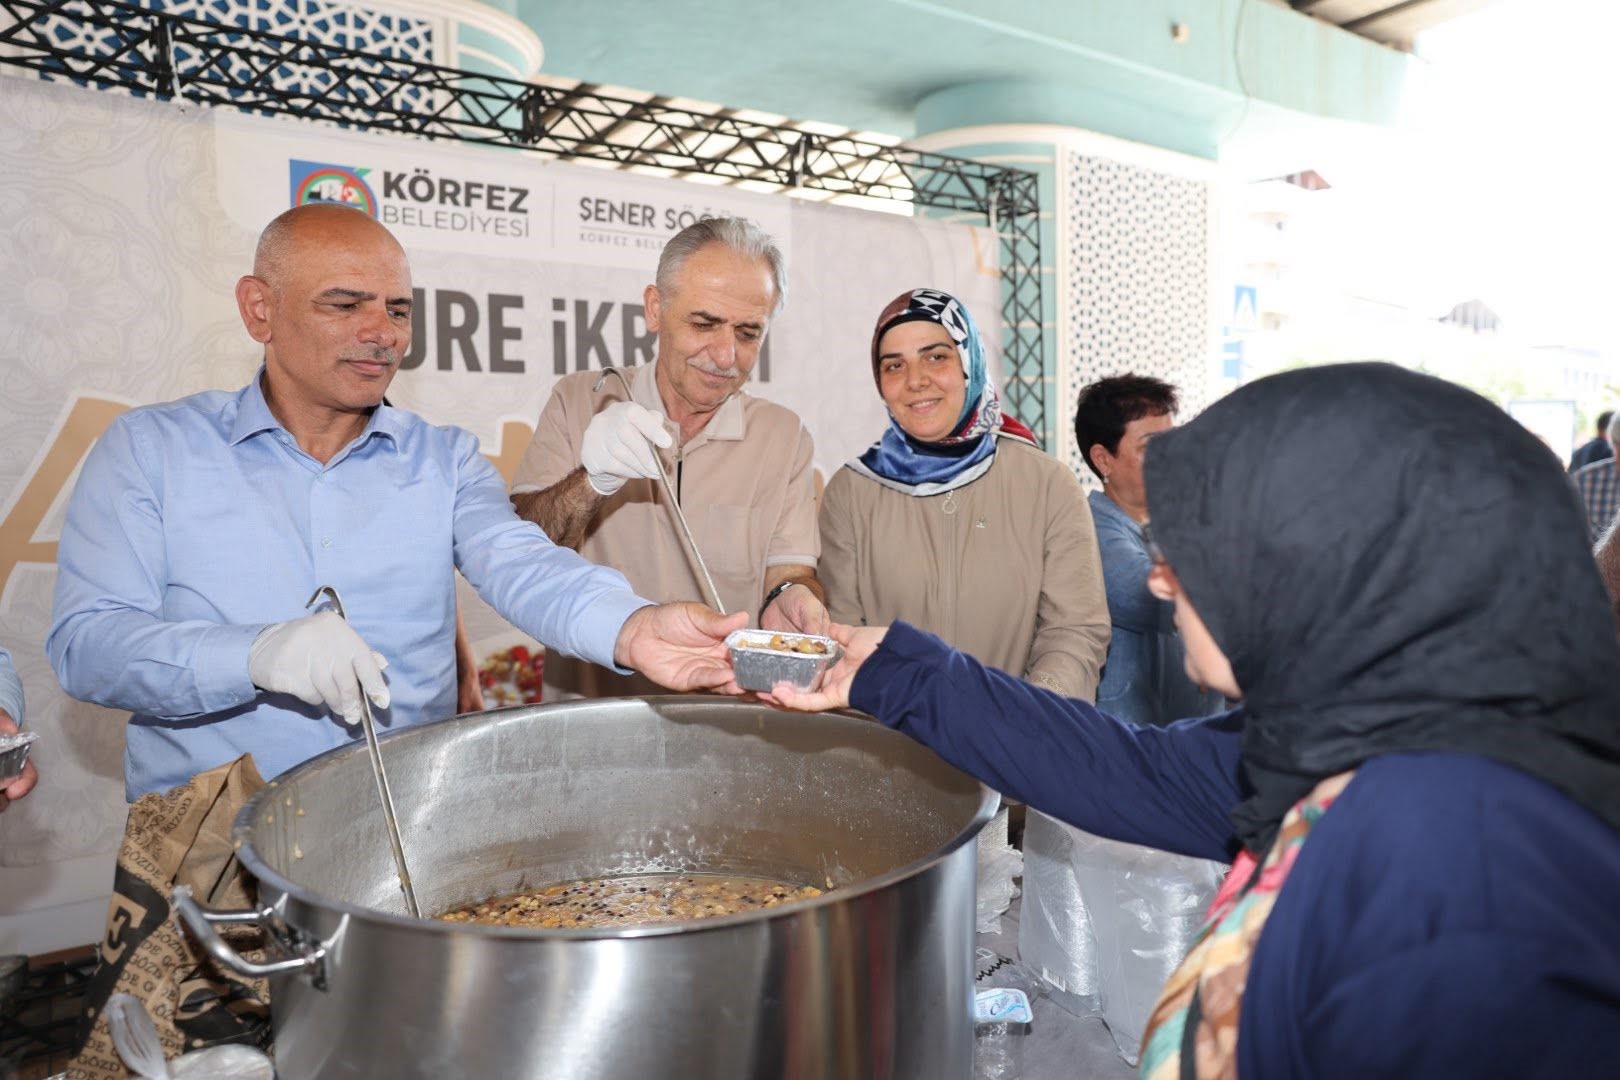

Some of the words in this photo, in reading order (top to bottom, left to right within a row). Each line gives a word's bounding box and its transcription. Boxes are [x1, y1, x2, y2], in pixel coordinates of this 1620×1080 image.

[383, 167, 530, 214] KÖRFEZ
[383, 204, 530, 238] BELEDİYESİ
[579, 197, 656, 229] ŞENER
